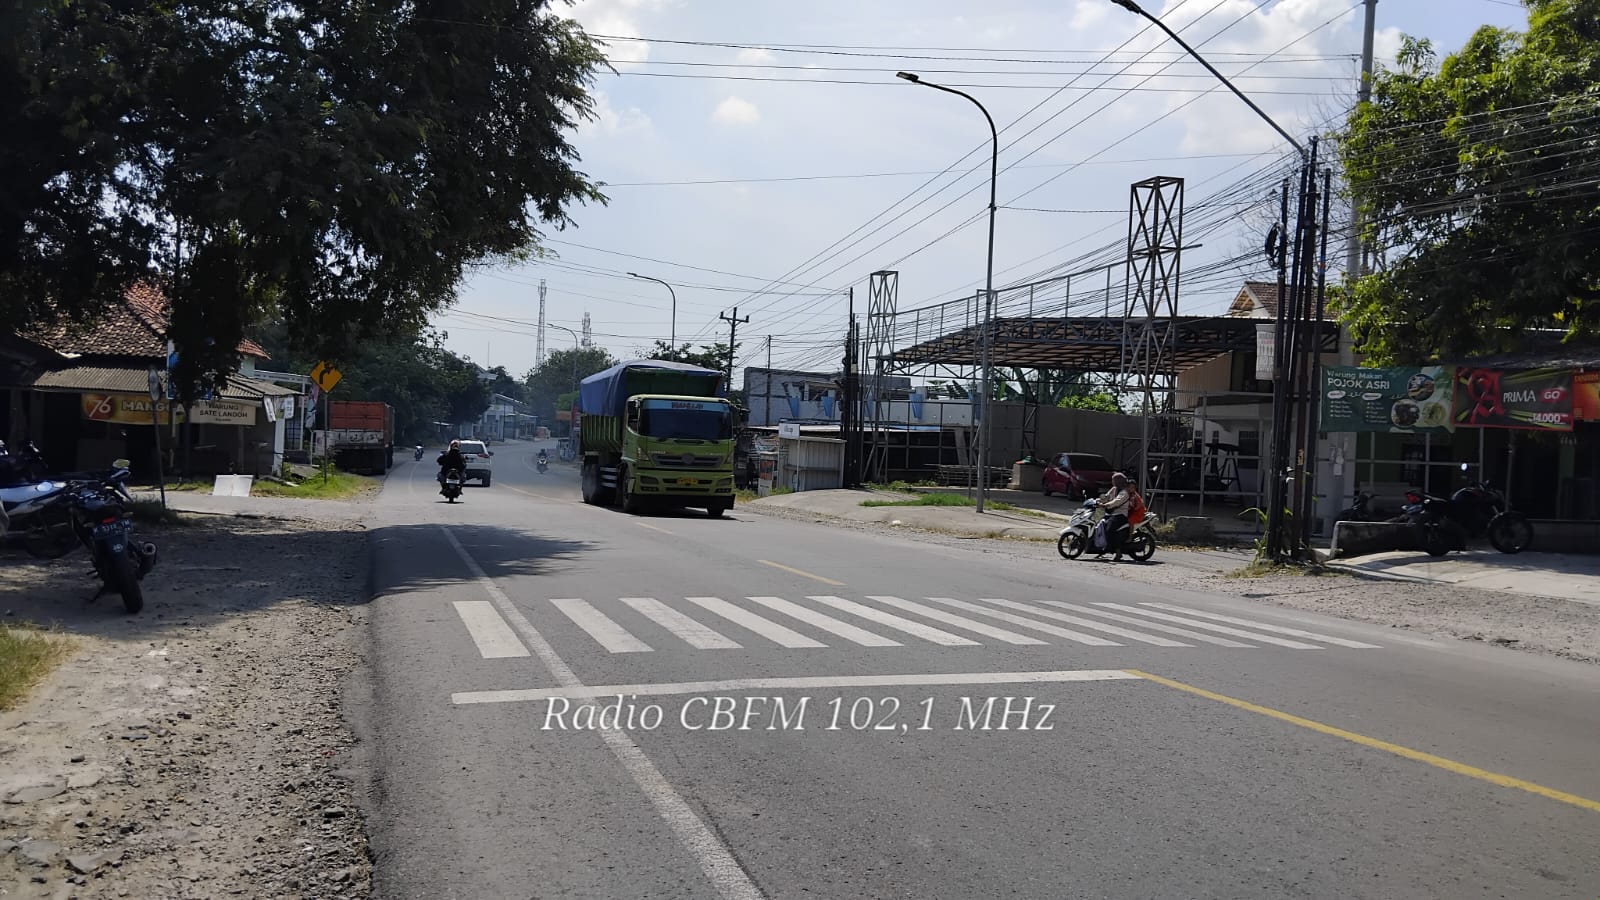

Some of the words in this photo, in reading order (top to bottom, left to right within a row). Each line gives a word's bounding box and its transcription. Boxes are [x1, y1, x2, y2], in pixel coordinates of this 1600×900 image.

[1326, 370, 1356, 379] Warung
[1327, 378, 1363, 389] POJOK
[1366, 381, 1390, 390] ASRI
[1503, 389, 1536, 403] PRIMA
[1544, 390, 1560, 400] GO
[88, 395, 112, 418] 76
[200, 409, 217, 417] SATE
